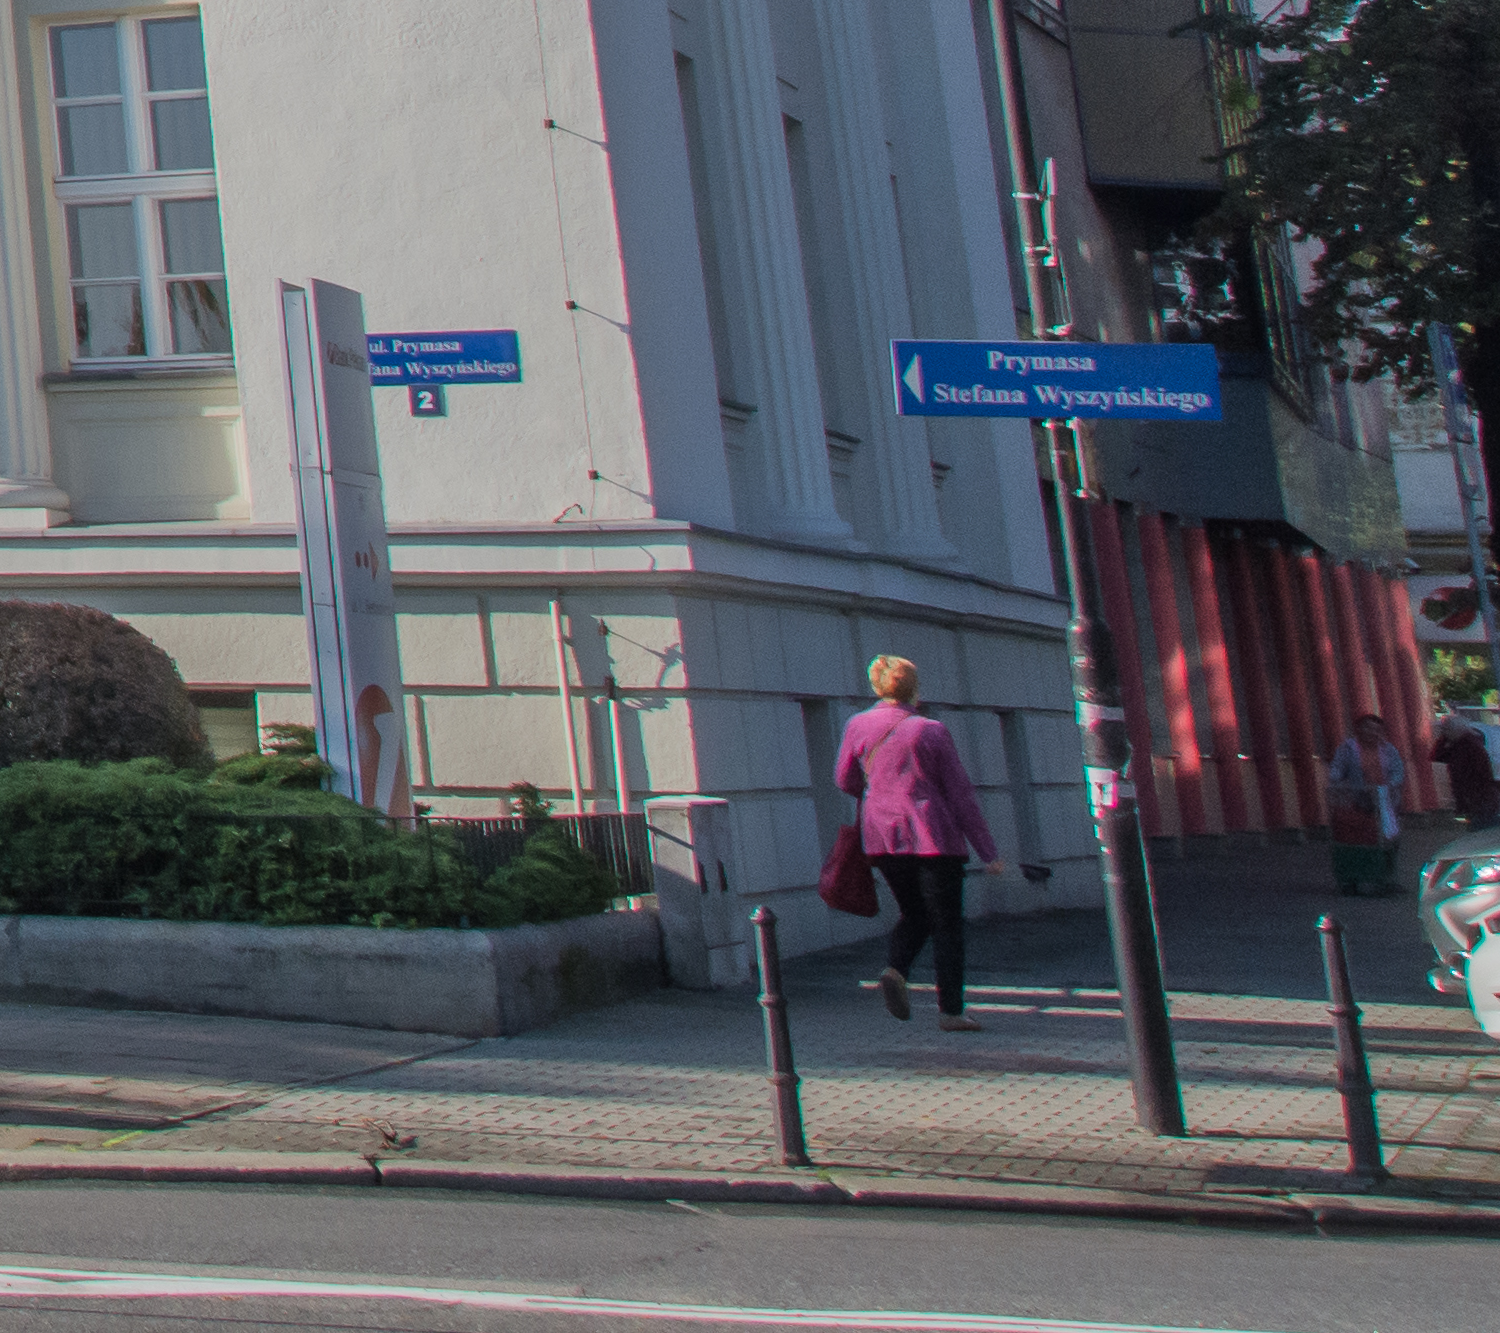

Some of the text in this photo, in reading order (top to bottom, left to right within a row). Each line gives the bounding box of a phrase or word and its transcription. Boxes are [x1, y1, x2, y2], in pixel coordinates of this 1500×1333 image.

[392, 339, 461, 355] Prymasa
[405, 359, 517, 379] Wyszyńskiego
[987, 350, 1096, 376] Prymasa
[417, 390, 434, 409] 2
[933, 383, 1213, 413] Stefana Wyszyńskiego
